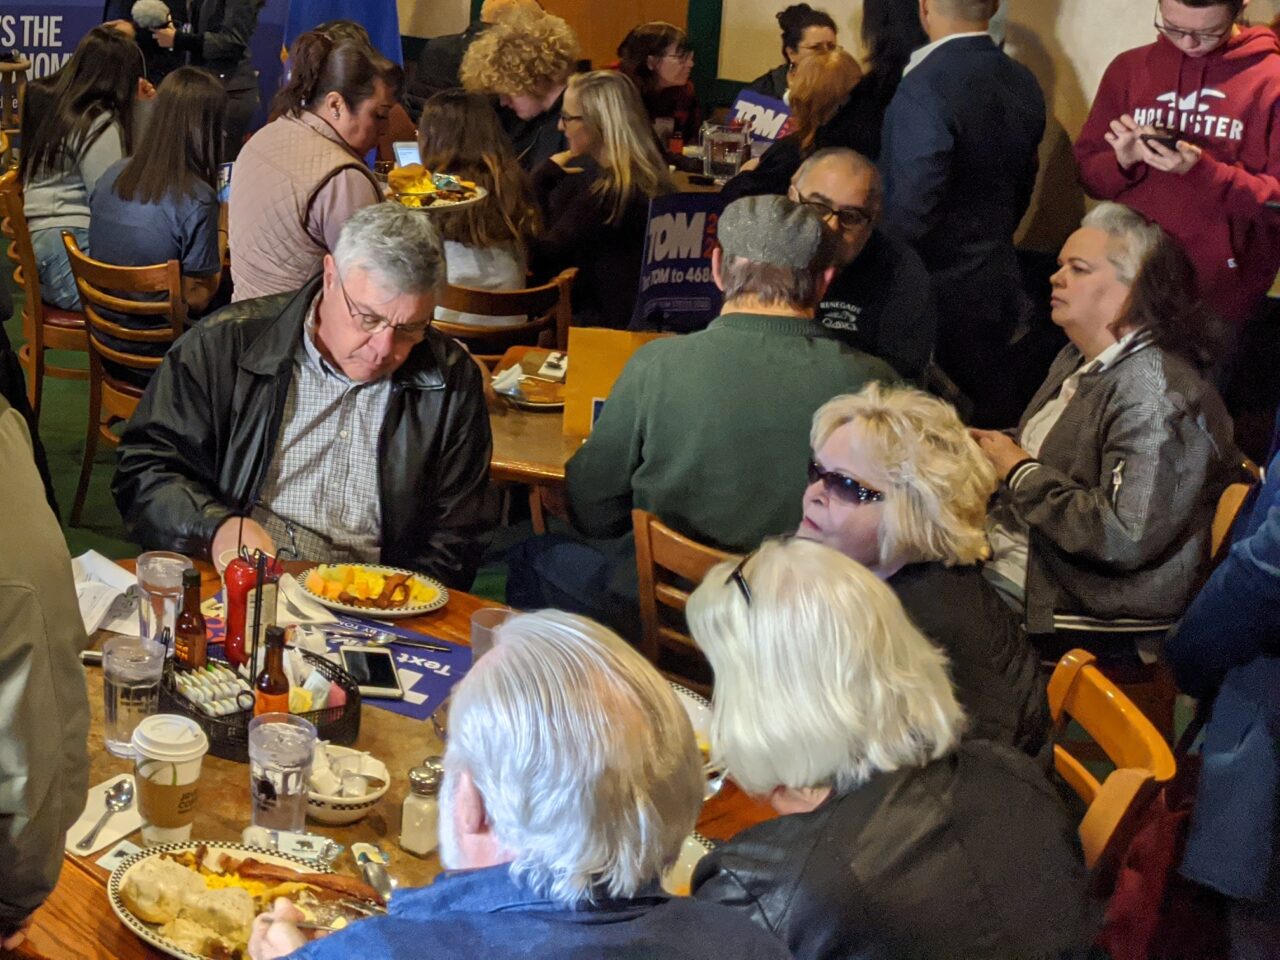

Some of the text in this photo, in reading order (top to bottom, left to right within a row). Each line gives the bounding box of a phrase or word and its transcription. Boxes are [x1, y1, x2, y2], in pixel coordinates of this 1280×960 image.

[20, 15, 63, 48] THE
[735, 100, 788, 140] TOM
[1133, 108, 1244, 140] HOLLISTER
[647, 212, 706, 265] TOM
[671, 269, 684, 283] to
[396, 652, 451, 677] Text
